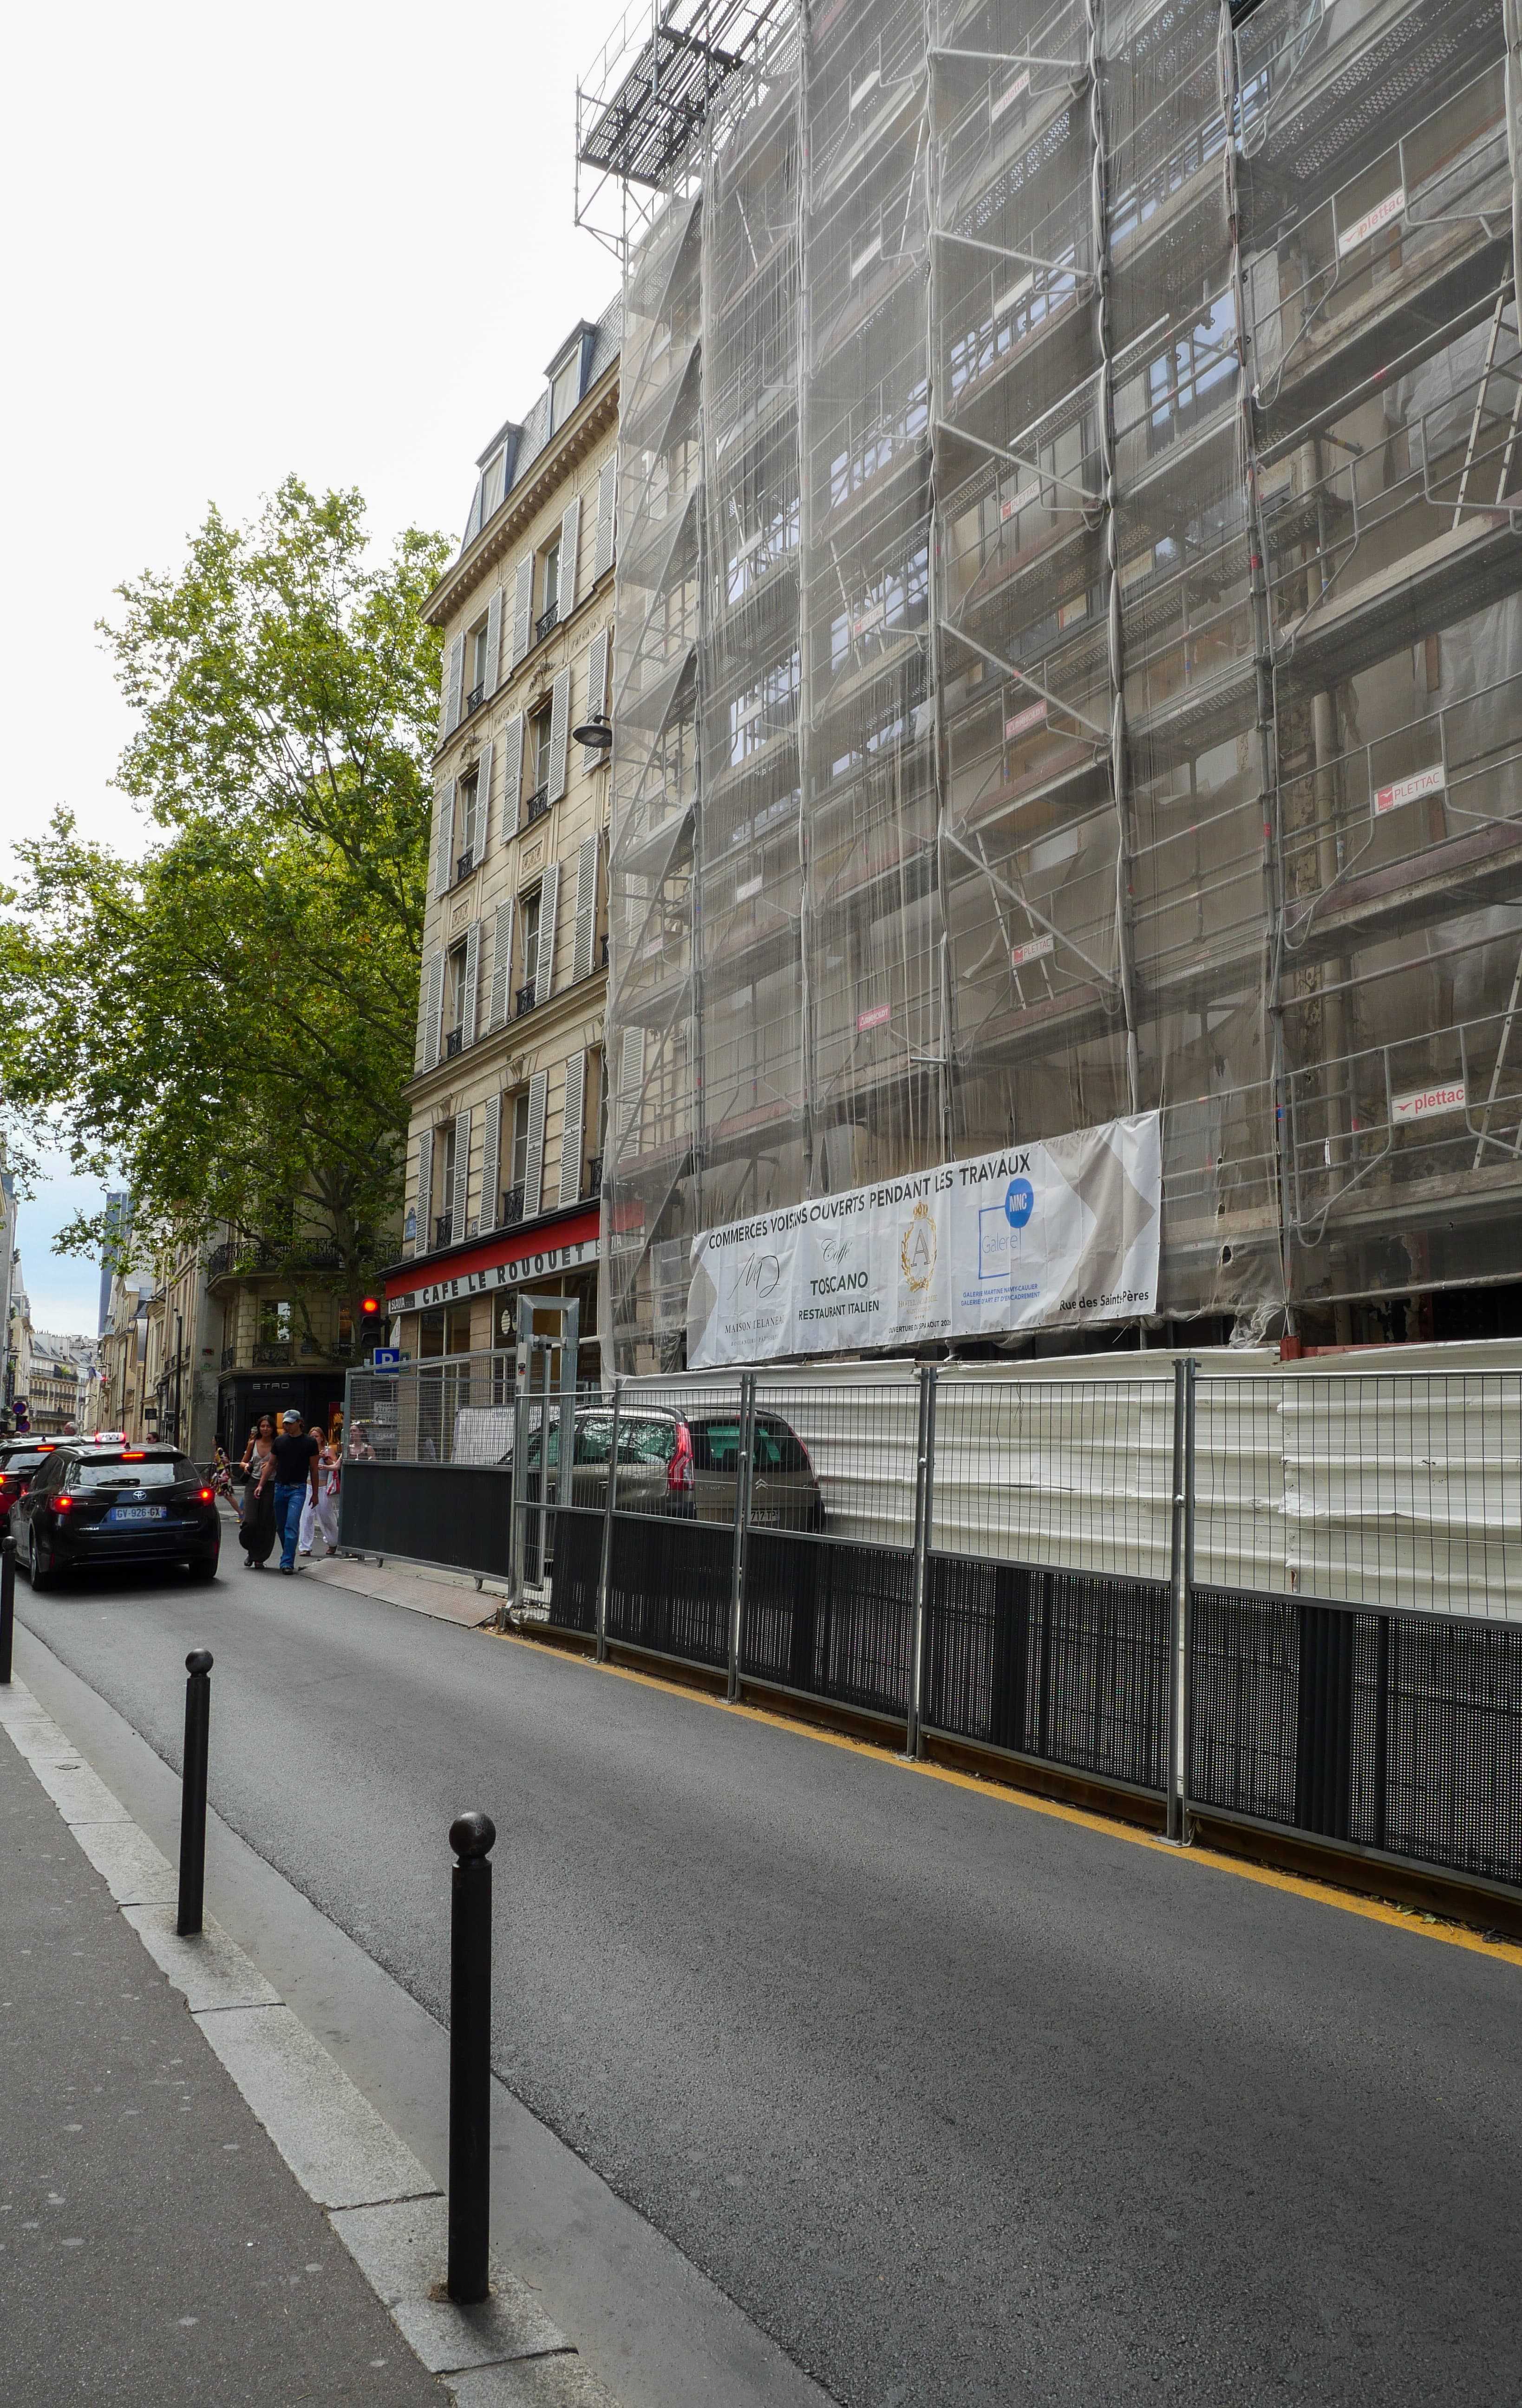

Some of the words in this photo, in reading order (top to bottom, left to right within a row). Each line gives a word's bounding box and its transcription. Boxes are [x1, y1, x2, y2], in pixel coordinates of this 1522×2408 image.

[1360, 193, 1404, 238] plettac
[1012, 483, 1037, 510] PLETTAC
[1394, 772, 1439, 800] PLETTAC
[1378, 801, 1393, 809] ALTRAD
[1024, 938, 1052, 956] PLETTAC
[1415, 1089, 1464, 1114] plettac
[709, 1221, 767, 1250] COMMERCES
[810, 1194, 865, 1222] OUVERTS
[870, 1177, 931, 1209] PENDANT
[935, 1170, 953, 1193] LES
[959, 1152, 1031, 1186] TRAVAUX
[1009, 1192, 1027, 1212] MNC
[423, 1280, 459, 1304] CAFE
[468, 1272, 486, 1292] LE
[497, 1243, 584, 1284] ROUQUET
[810, 1271, 869, 1296] TOSCANO
[1000, 1291, 1040, 1302] D'ENCADREMENT
[1059, 1300, 1077, 1311] Rue
[1079, 1296, 1097, 1309] des
[798, 1304, 846, 1321] RESTAURANT
[848, 1300, 879, 1315] ITALIEN
[725, 1321, 751, 1334] MAISON
[888, 1324, 914, 1334] OUVERTURE
[381, 1353, 394, 1364] P
[117, 1507, 160, 1518] GV-926-GX
